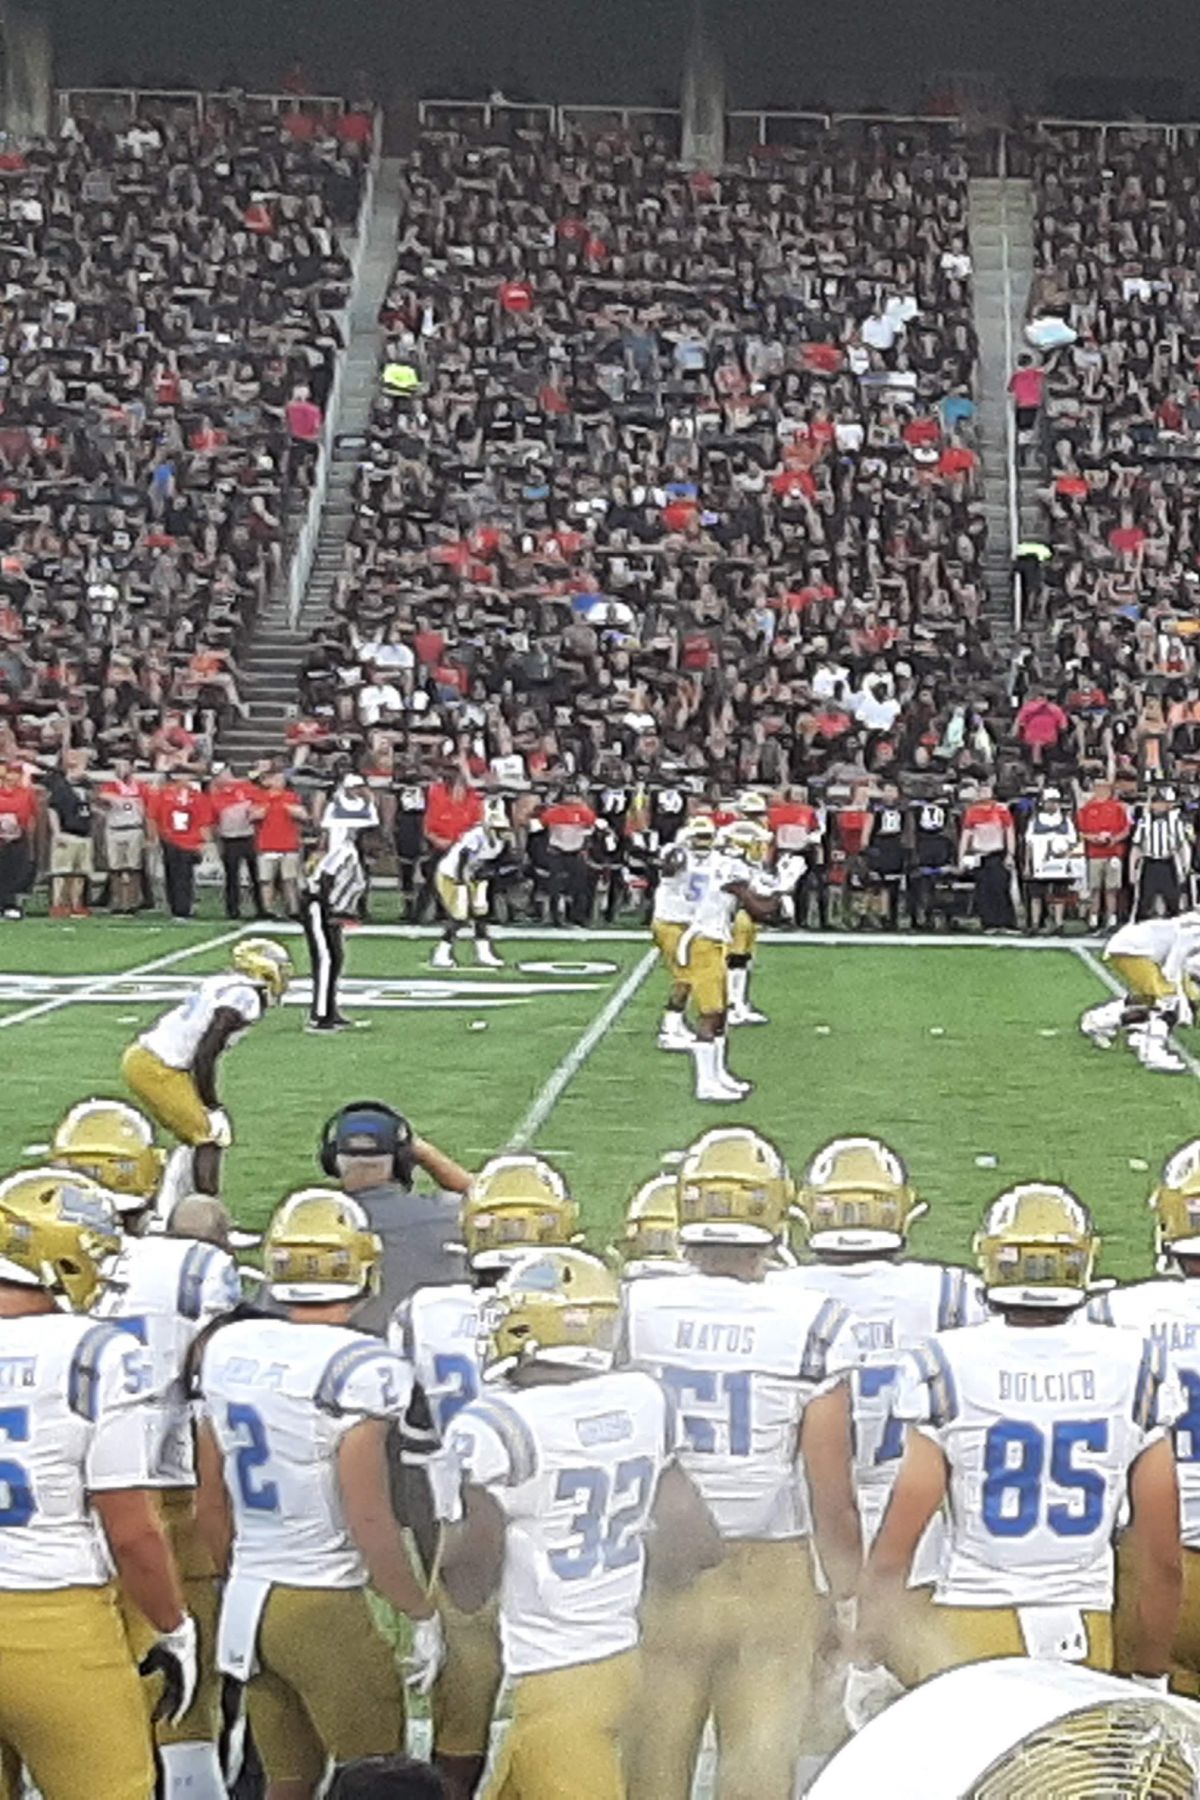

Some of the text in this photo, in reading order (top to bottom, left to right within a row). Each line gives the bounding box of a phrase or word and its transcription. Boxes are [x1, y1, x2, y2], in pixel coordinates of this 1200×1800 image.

[226, 1402, 282, 1510] 2
[982, 1417, 1109, 1538] 85
[548, 1454, 654, 1581] 32
